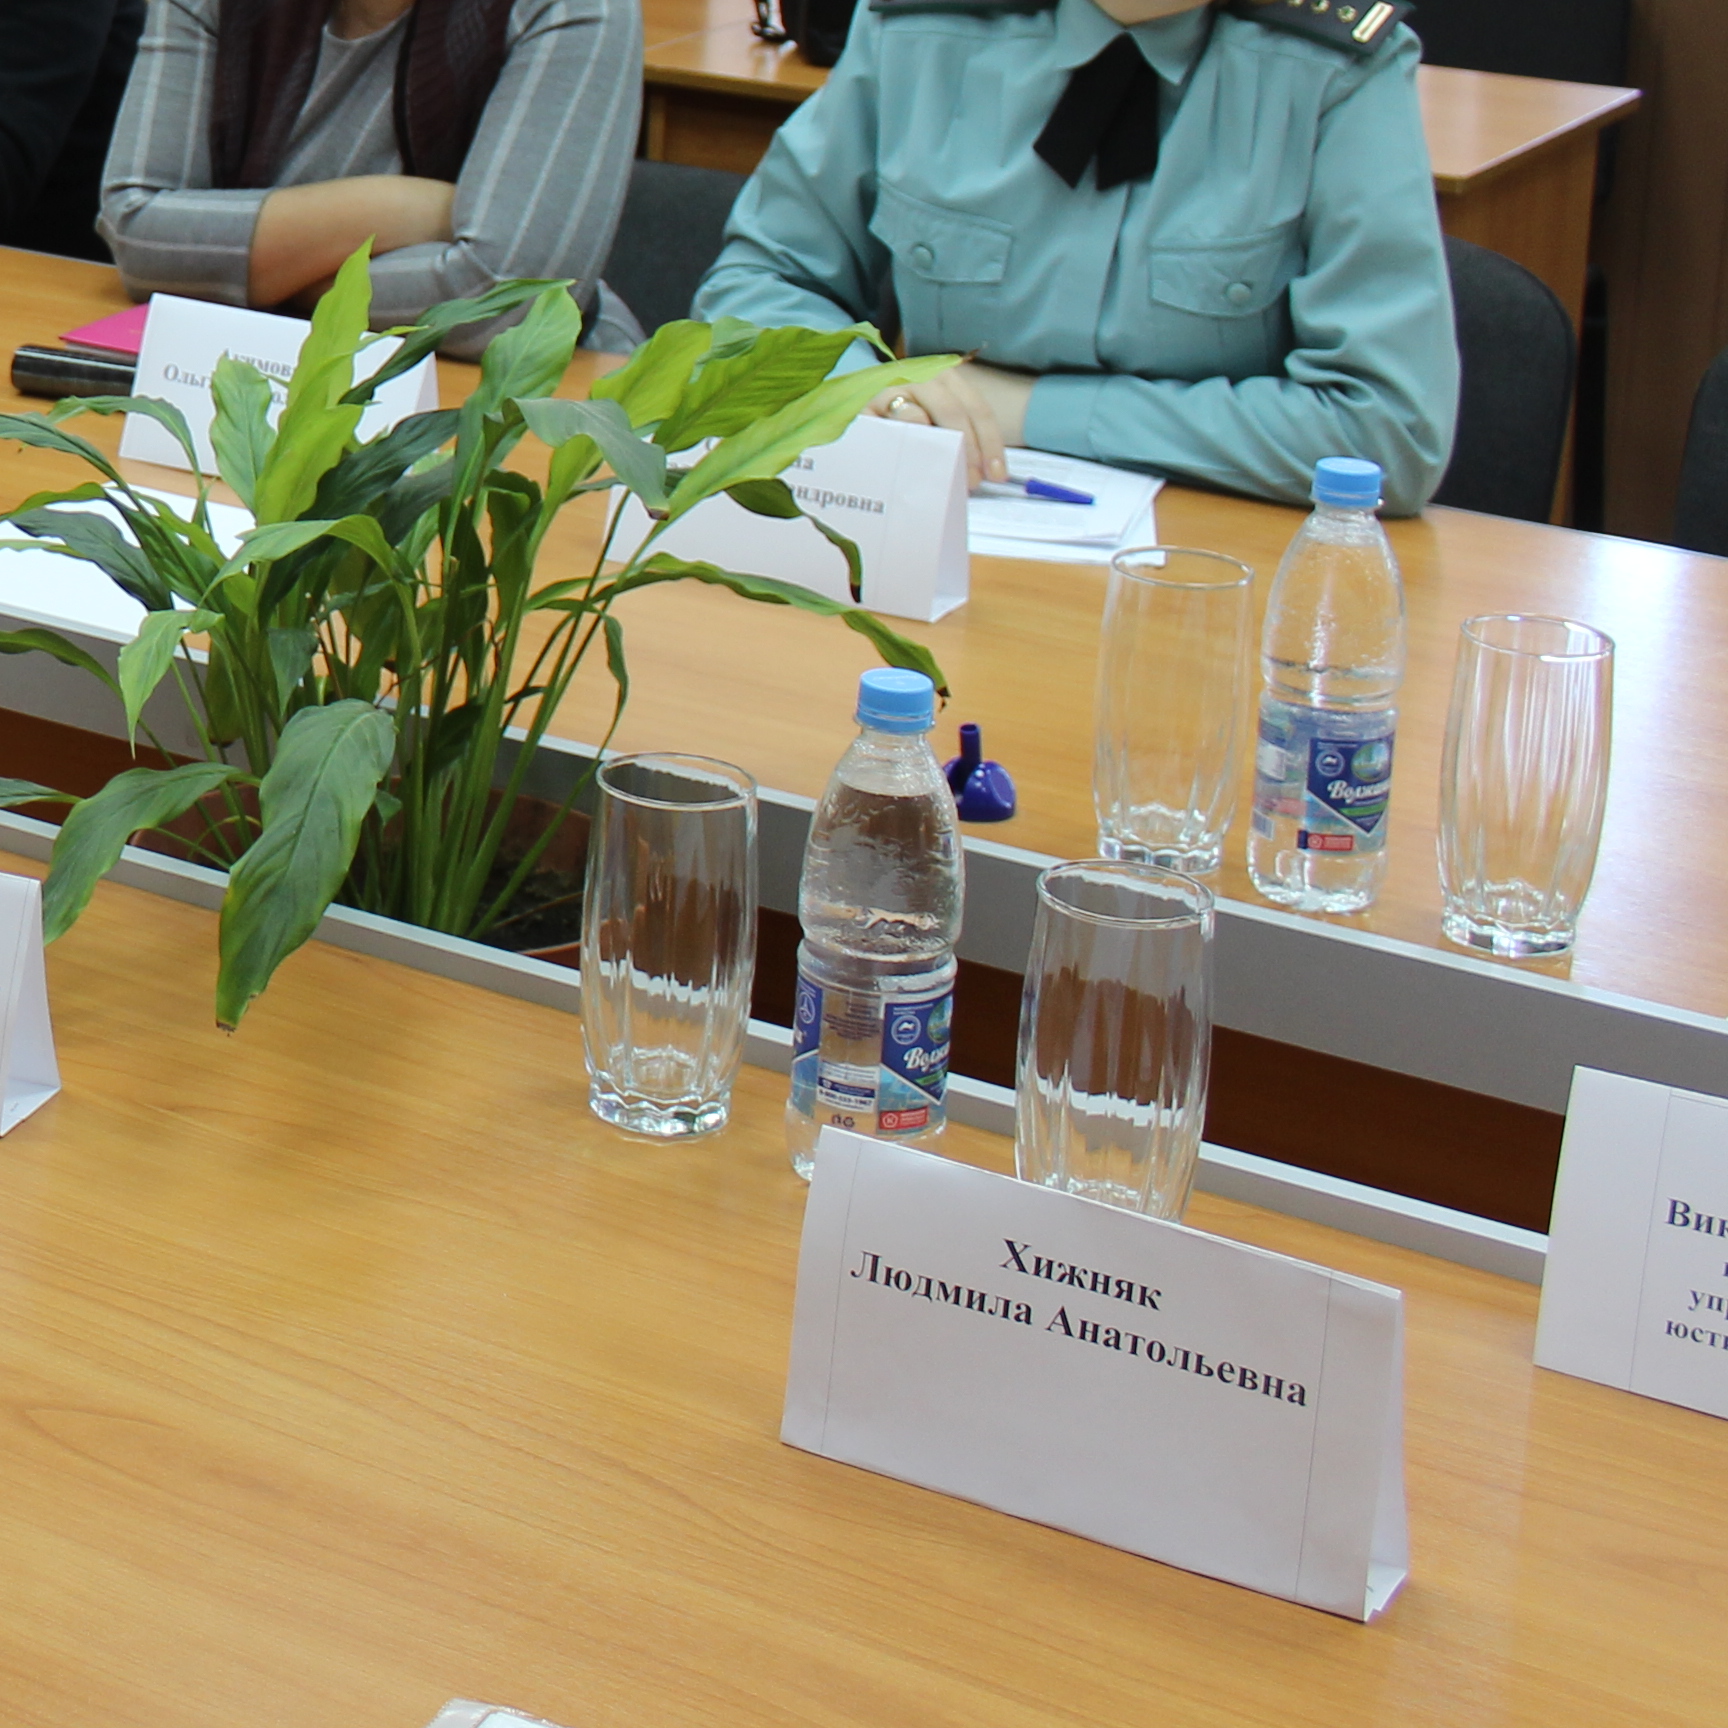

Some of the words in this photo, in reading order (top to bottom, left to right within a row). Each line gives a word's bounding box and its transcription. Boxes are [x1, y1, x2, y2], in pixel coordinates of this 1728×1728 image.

[850, 1250, 1033, 1327] Людмила
[1045, 1304, 1308, 1408] Анатольевна
[999, 1237, 1162, 1312] Хижняк
